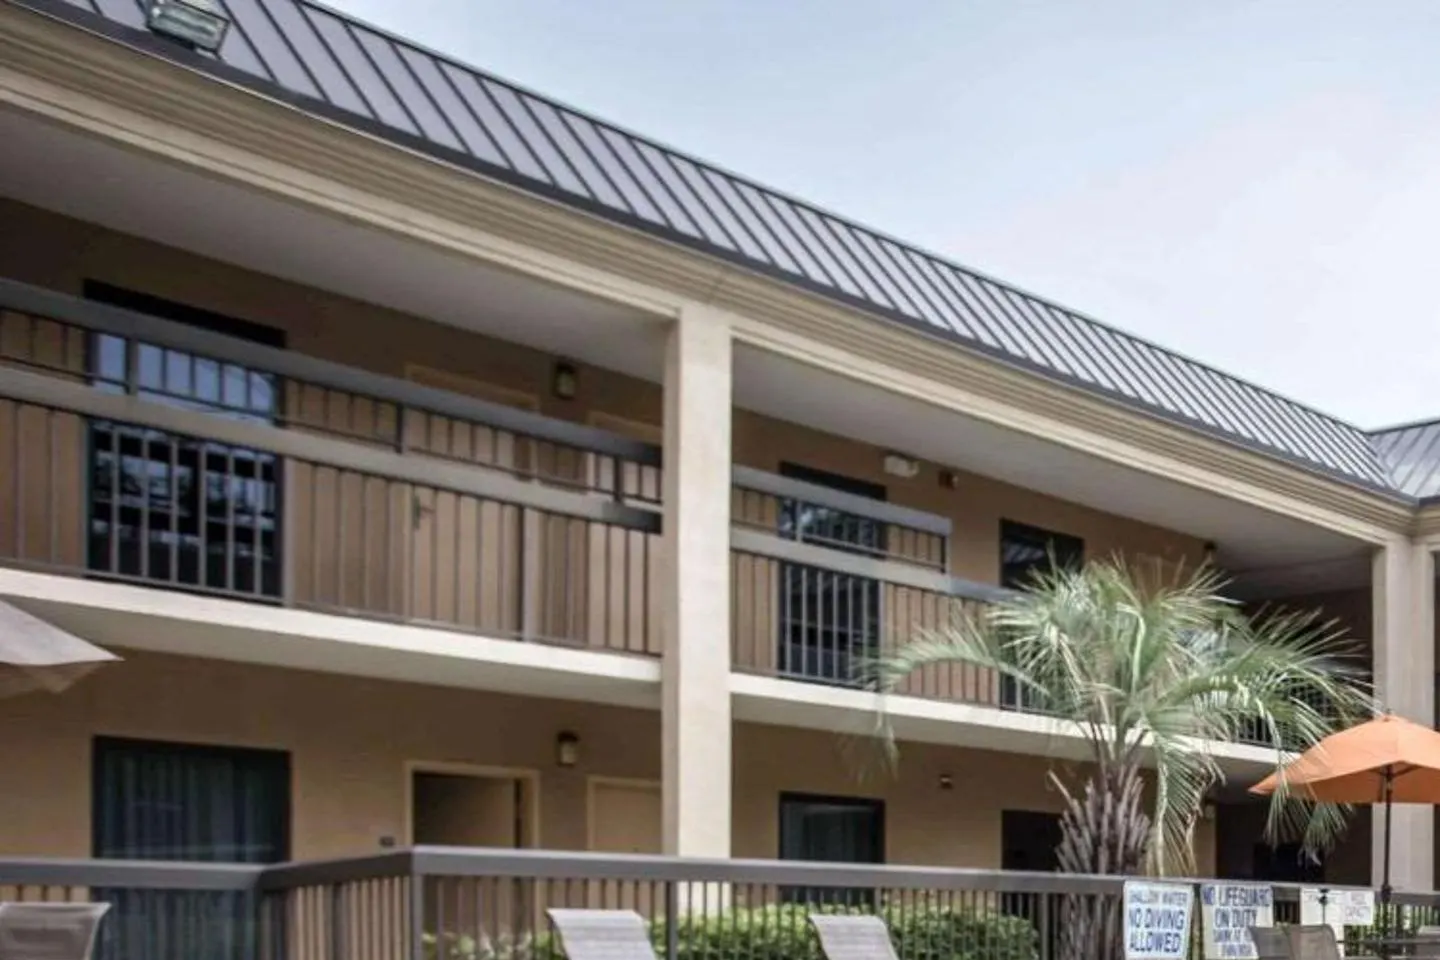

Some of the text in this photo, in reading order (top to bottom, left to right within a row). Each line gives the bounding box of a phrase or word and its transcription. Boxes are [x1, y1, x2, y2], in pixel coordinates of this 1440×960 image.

[1203, 885, 1215, 905] NO
[1129, 907, 1185, 930] NO DIVING
[1214, 907, 1258, 929] ON DUTY
[1130, 931, 1181, 953] ALLOWED
